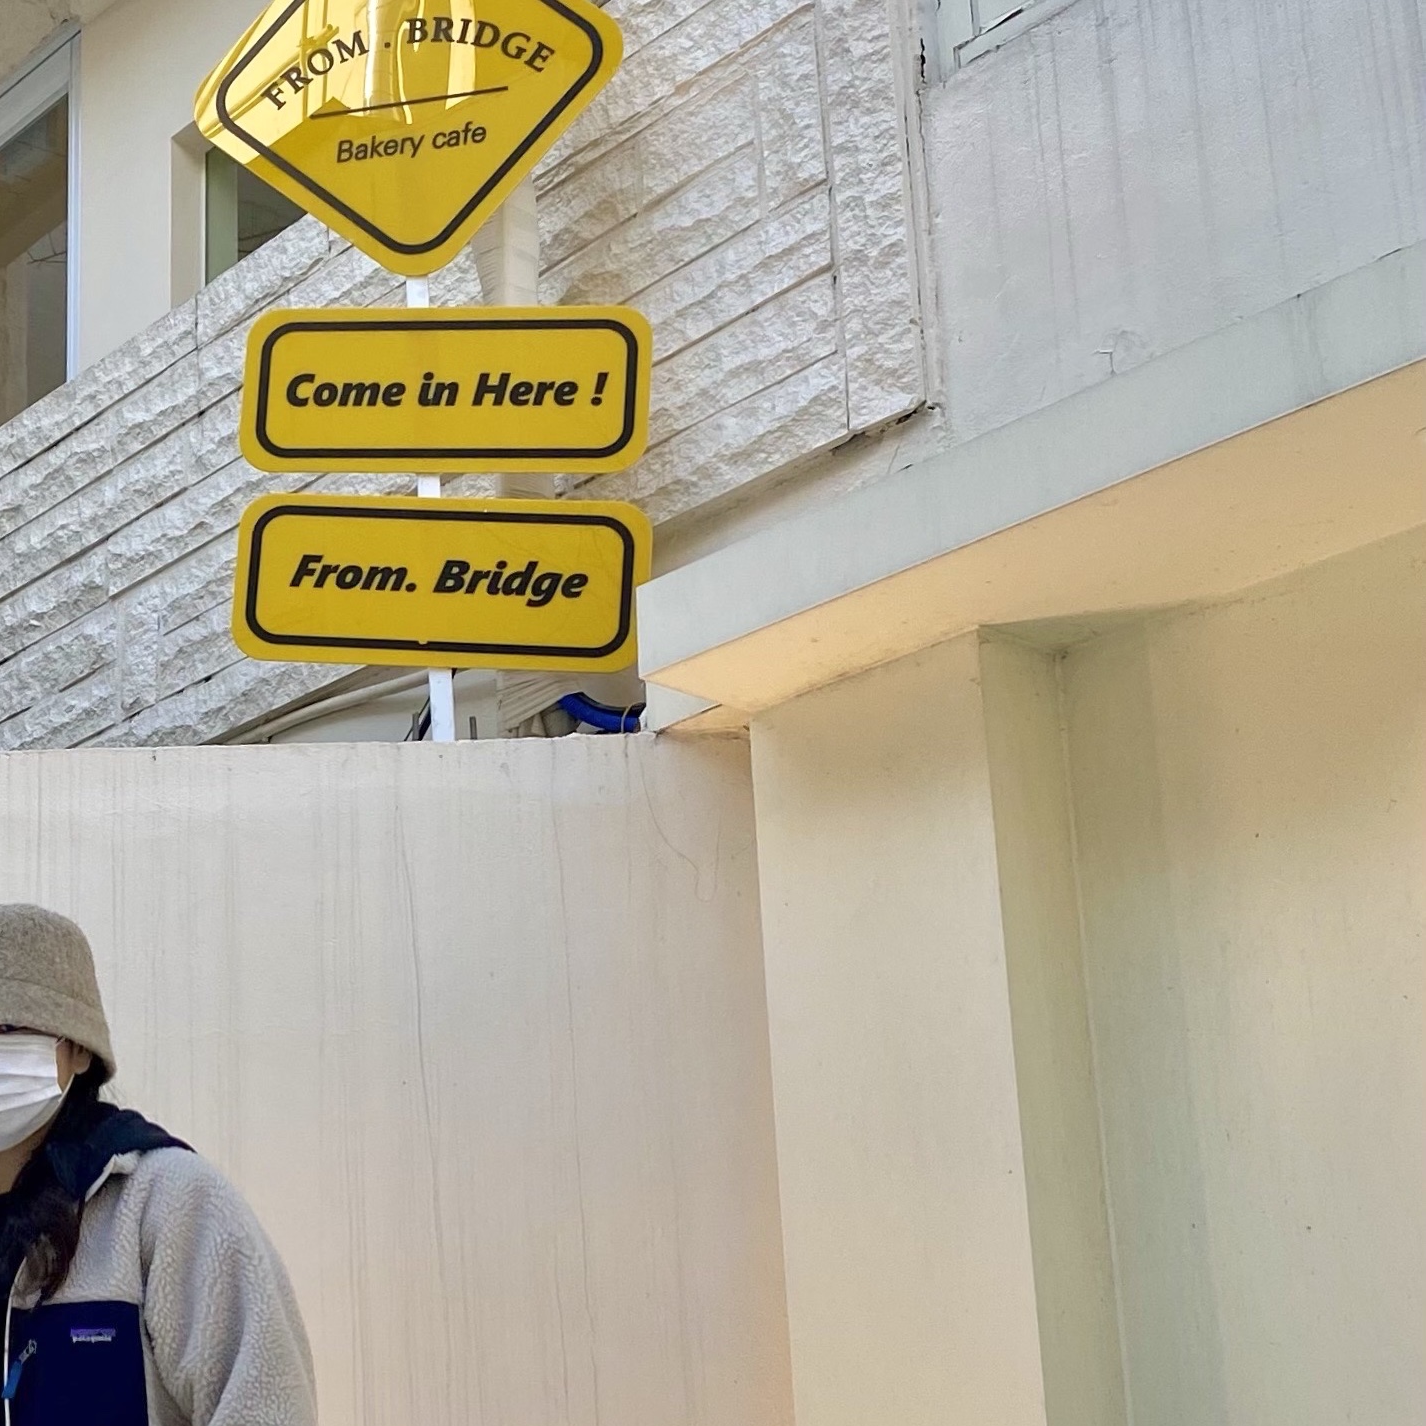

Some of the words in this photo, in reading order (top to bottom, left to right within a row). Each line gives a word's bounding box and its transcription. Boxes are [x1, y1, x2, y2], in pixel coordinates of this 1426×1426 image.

[261, 30, 369, 111] FROM
[406, 16, 556, 73] BRIDGE
[336, 133, 425, 164] Bakery
[432, 121, 488, 149] cafe
[286, 373, 406, 407] Come
[417, 372, 459, 406] in
[471, 373, 579, 406] Here
[289, 555, 417, 593] From.
[433, 560, 590, 608] Bridge
